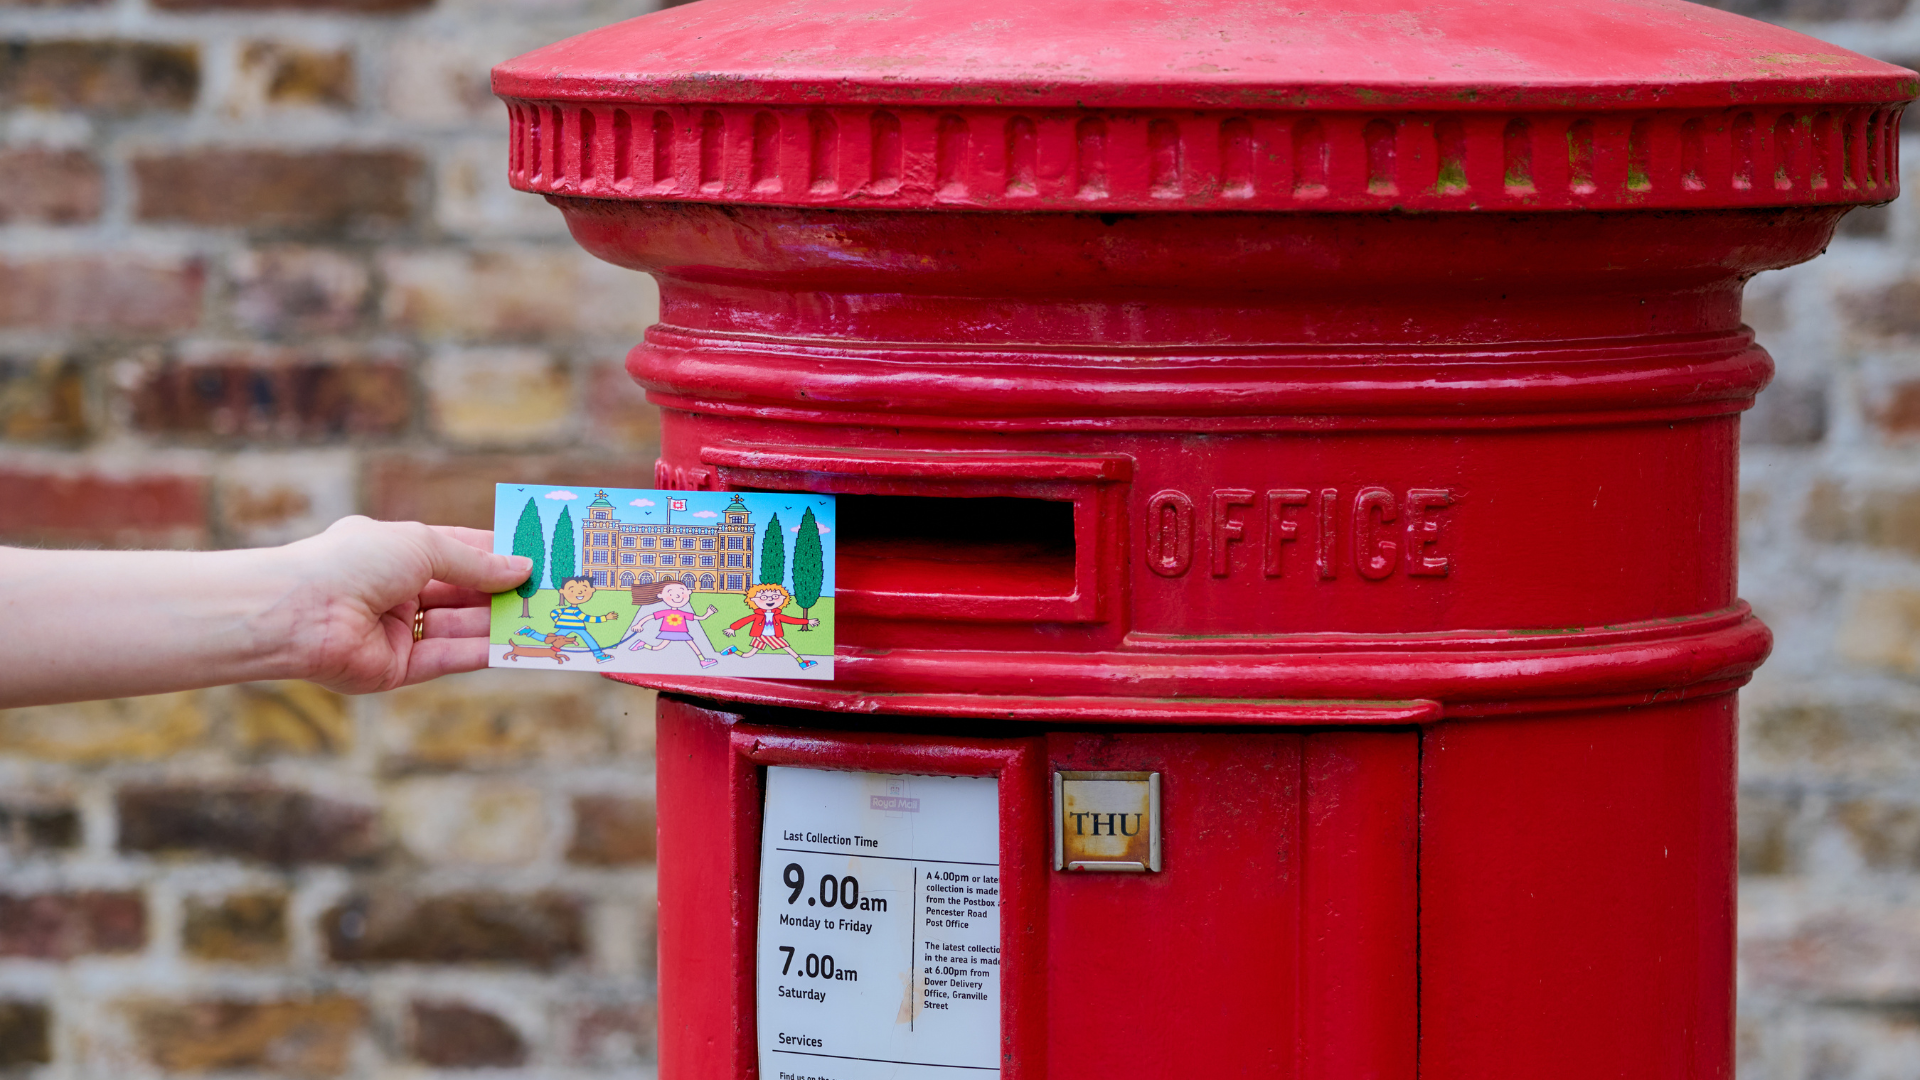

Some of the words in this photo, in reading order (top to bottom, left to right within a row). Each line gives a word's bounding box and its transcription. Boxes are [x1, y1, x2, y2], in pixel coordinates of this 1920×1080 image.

[1145, 487, 1453, 580] OFFICE
[872, 797, 897, 809] Royal
[898, 799, 918, 809] Mail
[1069, 811, 1144, 838] THU
[783, 830, 804, 842] Last
[806, 832, 851, 846] Collection
[854, 835, 878, 848] Time
[926, 871, 932, 880] A
[934, 871, 969, 883] 4.00pm
[983, 875, 999, 884] late
[783, 862, 888, 912] 9.00am
[926, 884, 964, 893] collection
[966, 886, 973, 894] is
[976, 887, 998, 895] made
[926, 895, 945, 904] from
[948, 896, 961, 905] the
[963, 897, 995, 907] Postbox
[926, 906, 965, 917] Pencester
[967, 909, 988, 918] Road
[779, 914, 821, 930] Monday
[824, 918, 835, 929] to
[838, 919, 873, 934] Friday
[925, 918, 943, 927] Post
[945, 919, 969, 929] Office
[925, 941, 940, 950] The
[942, 942, 965, 952] latest
[967, 944, 1000, 954] collectio
[779, 945, 858, 981] 7.00am
[924, 953, 932, 962] in
[934, 954, 948, 963] the
[950, 956, 968, 964] area
[970, 955, 978, 964] is
[924, 966, 932, 974] at
[935, 966, 968, 977] 6.00pm
[970, 968, 990, 978] from
[924, 977, 948, 987] Dover
[950, 979, 983, 990] Delivery
[778, 985, 826, 1003] Saturday
[924, 988, 950, 999] Office,
[952, 990, 988, 1001] Granville
[923, 1000, 949, 1010] Street
[778, 1032, 823, 1048] Services
[779, 1071, 795, 1080] Find
